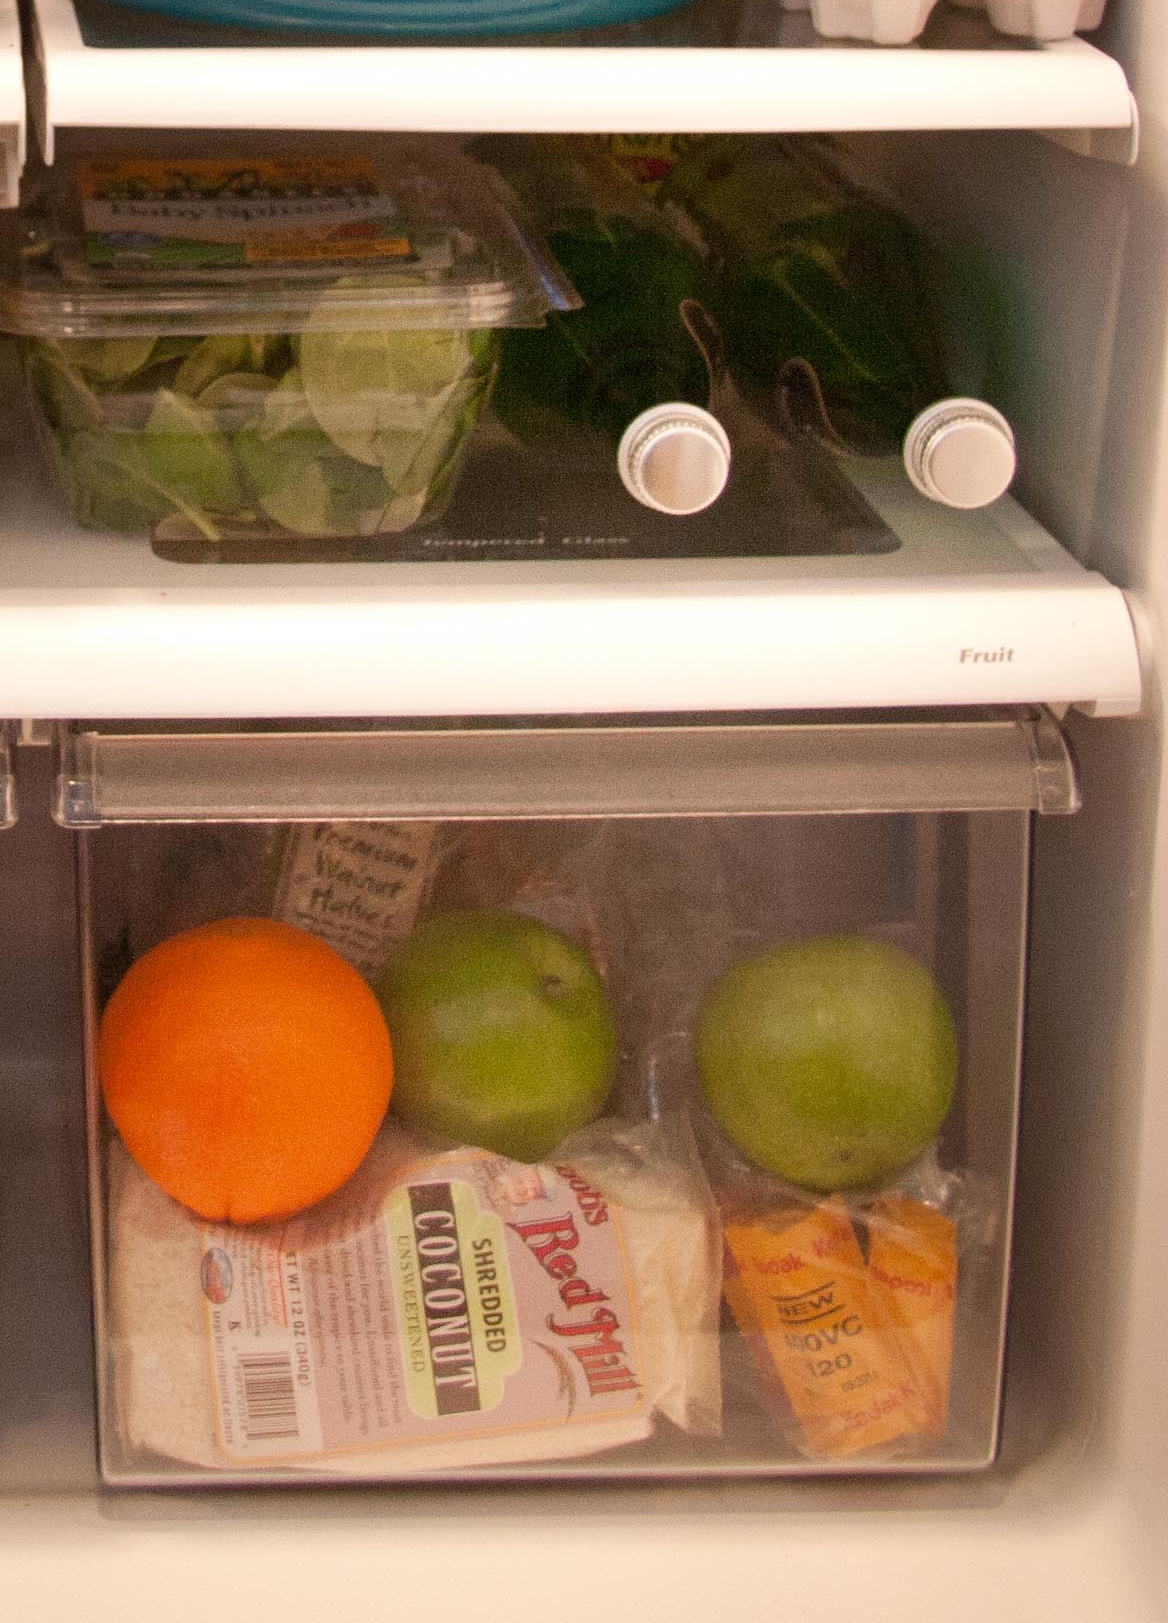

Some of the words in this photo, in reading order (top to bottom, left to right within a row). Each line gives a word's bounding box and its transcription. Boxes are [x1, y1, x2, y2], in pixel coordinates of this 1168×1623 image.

[959, 645, 1015, 664] Fruit
[395, 1234, 426, 1375] UNSWEETENED
[414, 1208, 479, 1389] COCONUT
[470, 1237, 509, 1354] SHREDDED
[505, 1211, 611, 1311] Red
[777, 1291, 835, 1317] NEW
[545, 1306, 644, 1398] Mill
